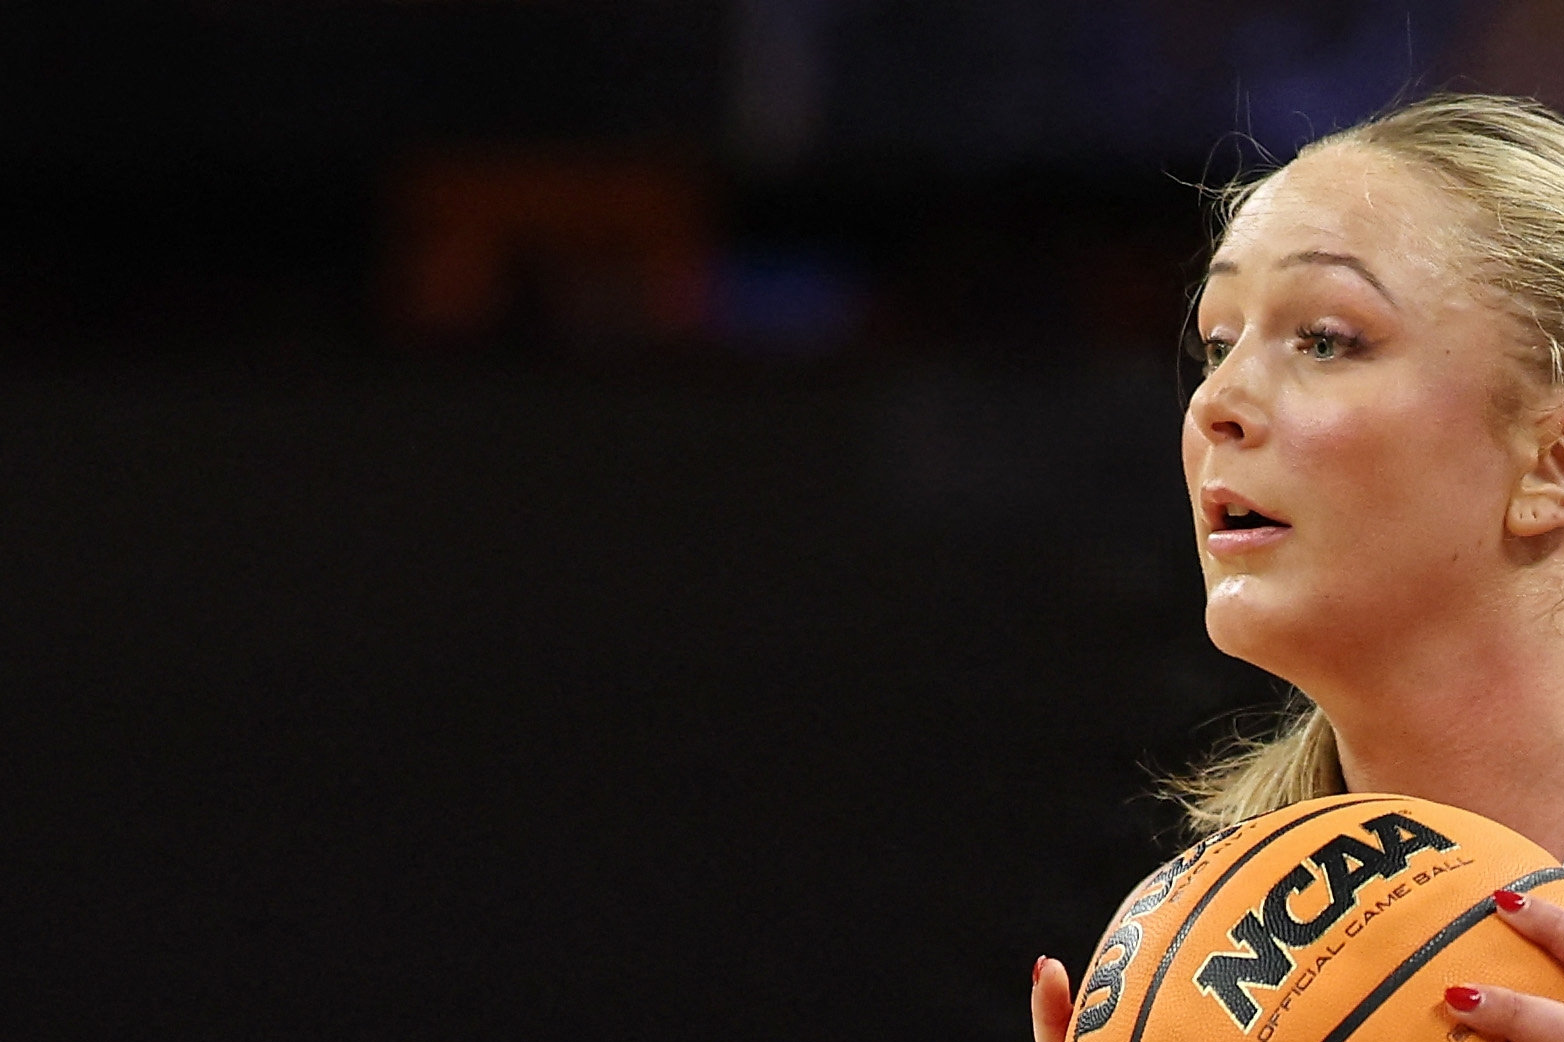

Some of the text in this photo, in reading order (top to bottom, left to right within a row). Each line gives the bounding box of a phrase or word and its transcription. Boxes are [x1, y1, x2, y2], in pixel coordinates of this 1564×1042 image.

[1192, 812, 1461, 1034] NCAA
[1257, 857, 1475, 1042] OFFICIAL GAME BALL
